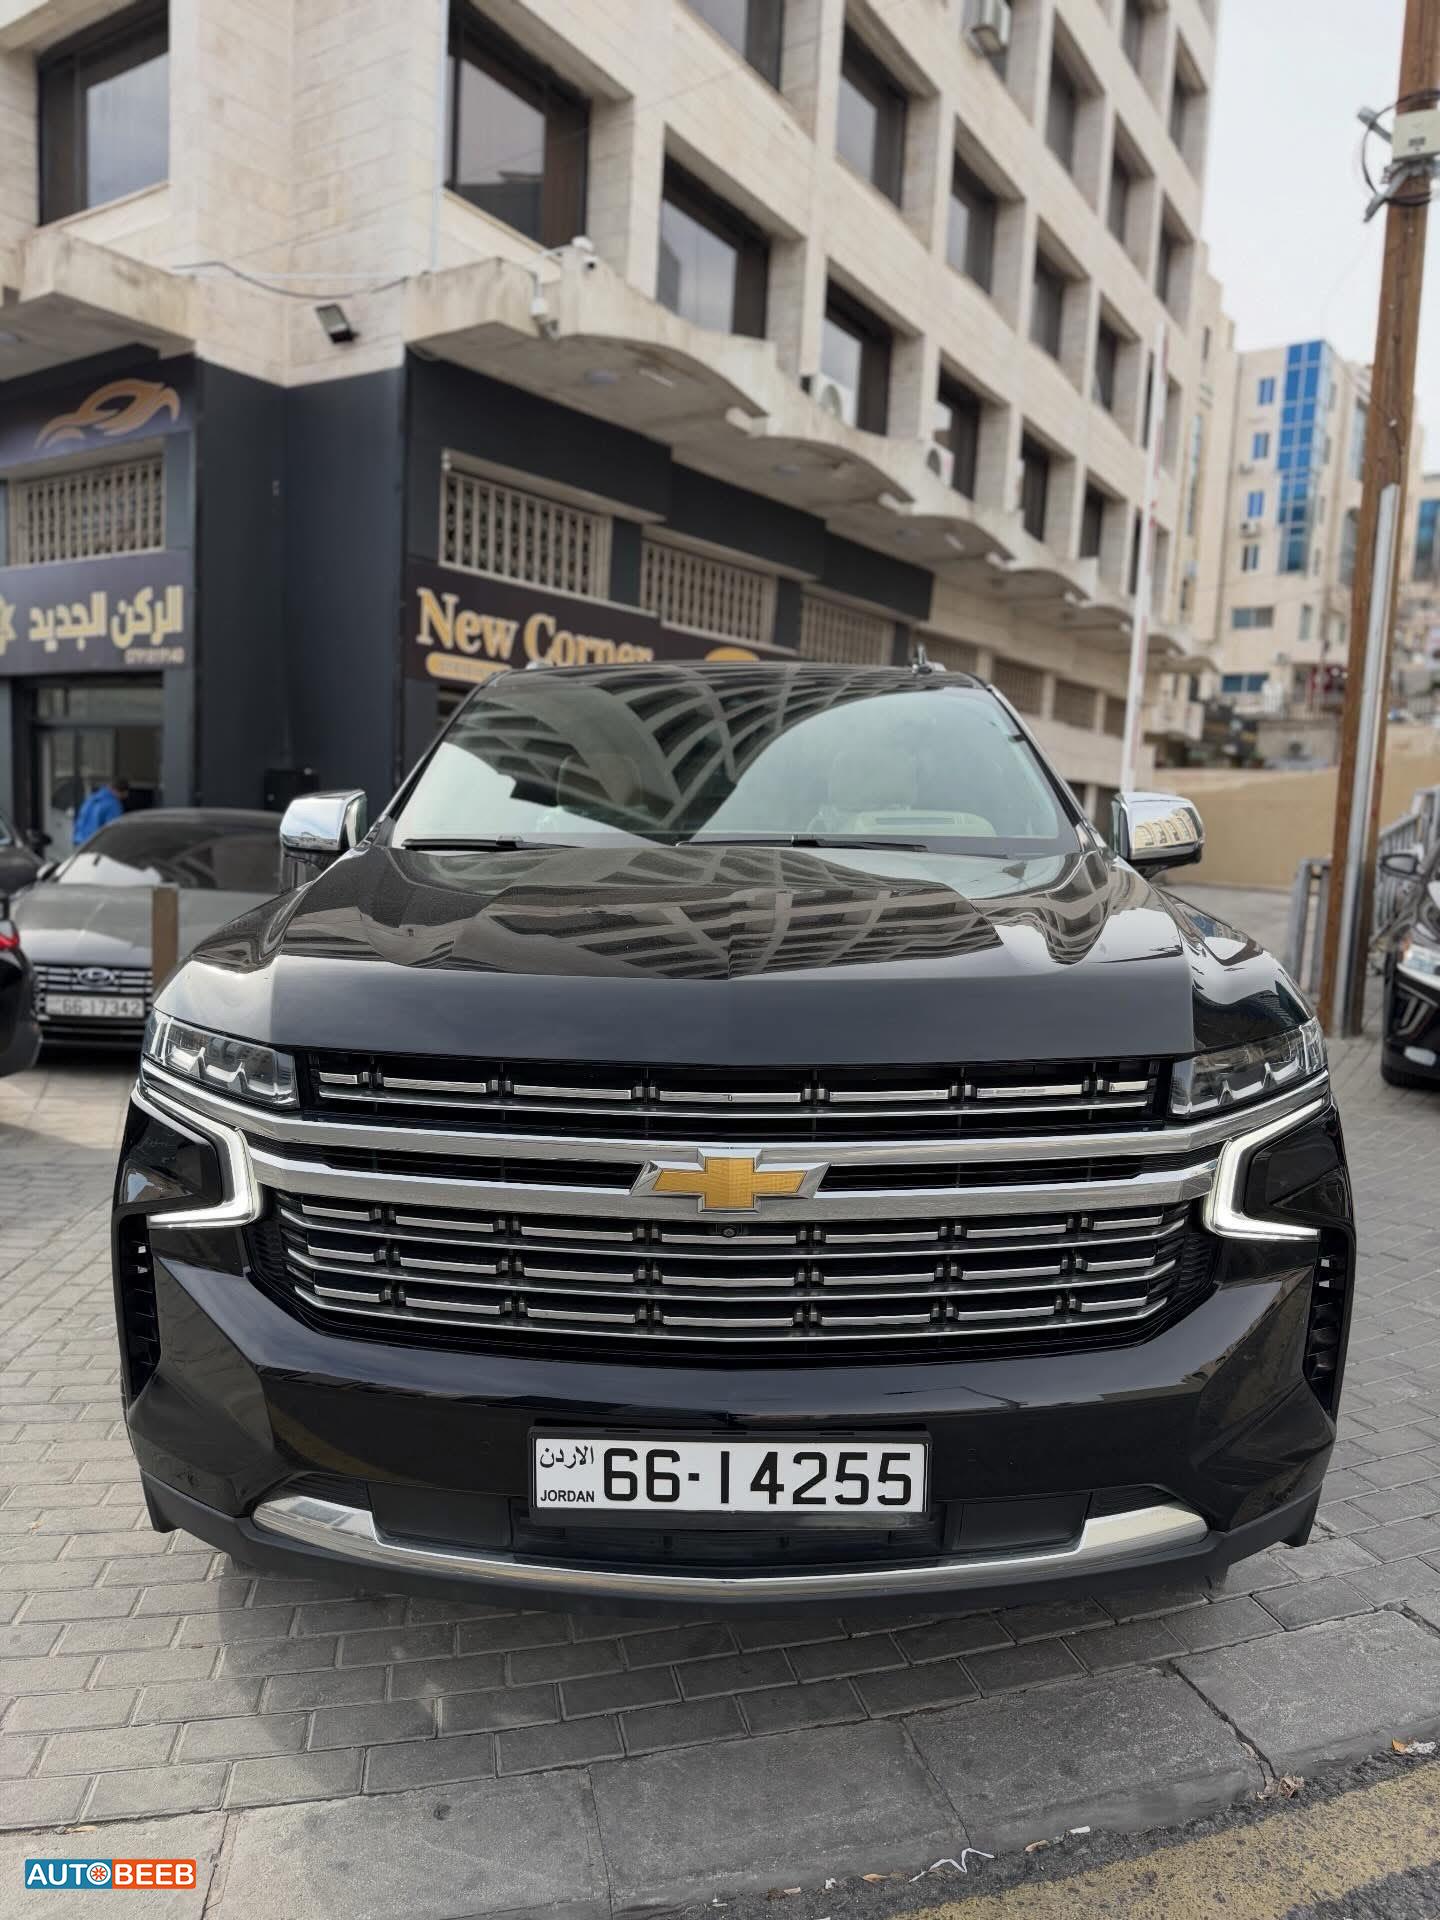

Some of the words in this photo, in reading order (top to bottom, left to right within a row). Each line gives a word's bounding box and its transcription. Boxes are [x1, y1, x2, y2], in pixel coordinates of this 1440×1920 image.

[29, 591, 108, 653] الجديد
[111, 585, 184, 649] الركن
[416, 587, 519, 660] New
[524, 613, 654, 667] Corner
[540, 1445, 595, 1469] الاردن
[603, 1447, 912, 1506] 66-14255
[540, 1489, 595, 1503] JORDAN
